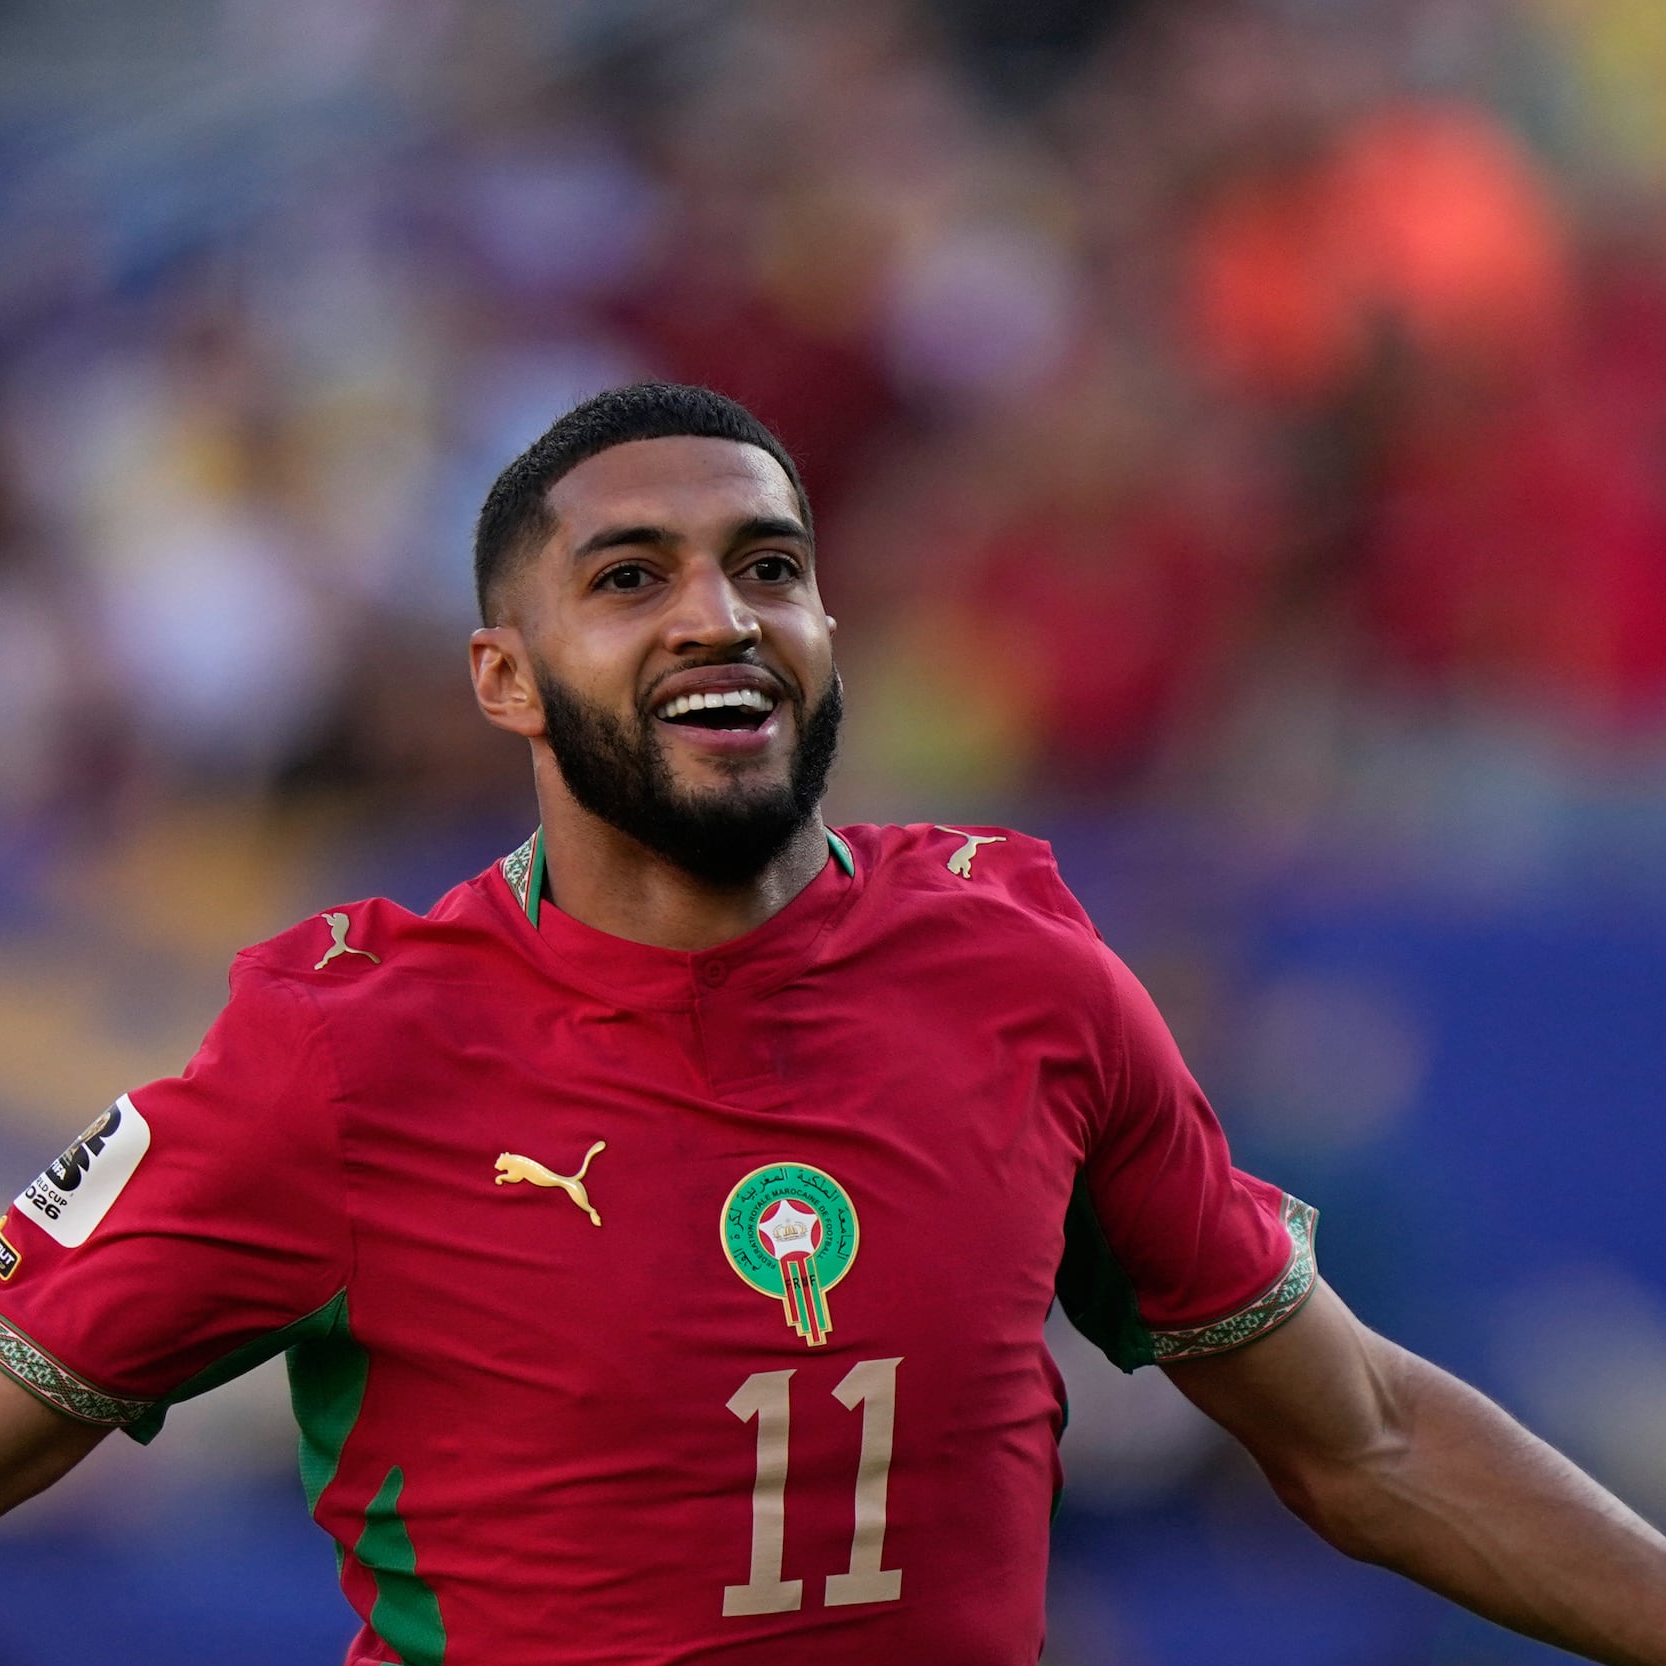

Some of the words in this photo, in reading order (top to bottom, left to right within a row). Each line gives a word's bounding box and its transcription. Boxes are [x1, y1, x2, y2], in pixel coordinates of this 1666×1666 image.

[25, 1185, 61, 1220] 026
[48, 1190, 68, 1206] CUP
[749, 1193, 773, 1223] ROYALE
[771, 1188, 820, 1206] MAROCAINE
[818, 1205, 830, 1217] DE
[817, 1218, 833, 1260] FOOTBALL
[722, 1356, 905, 1617] 11
